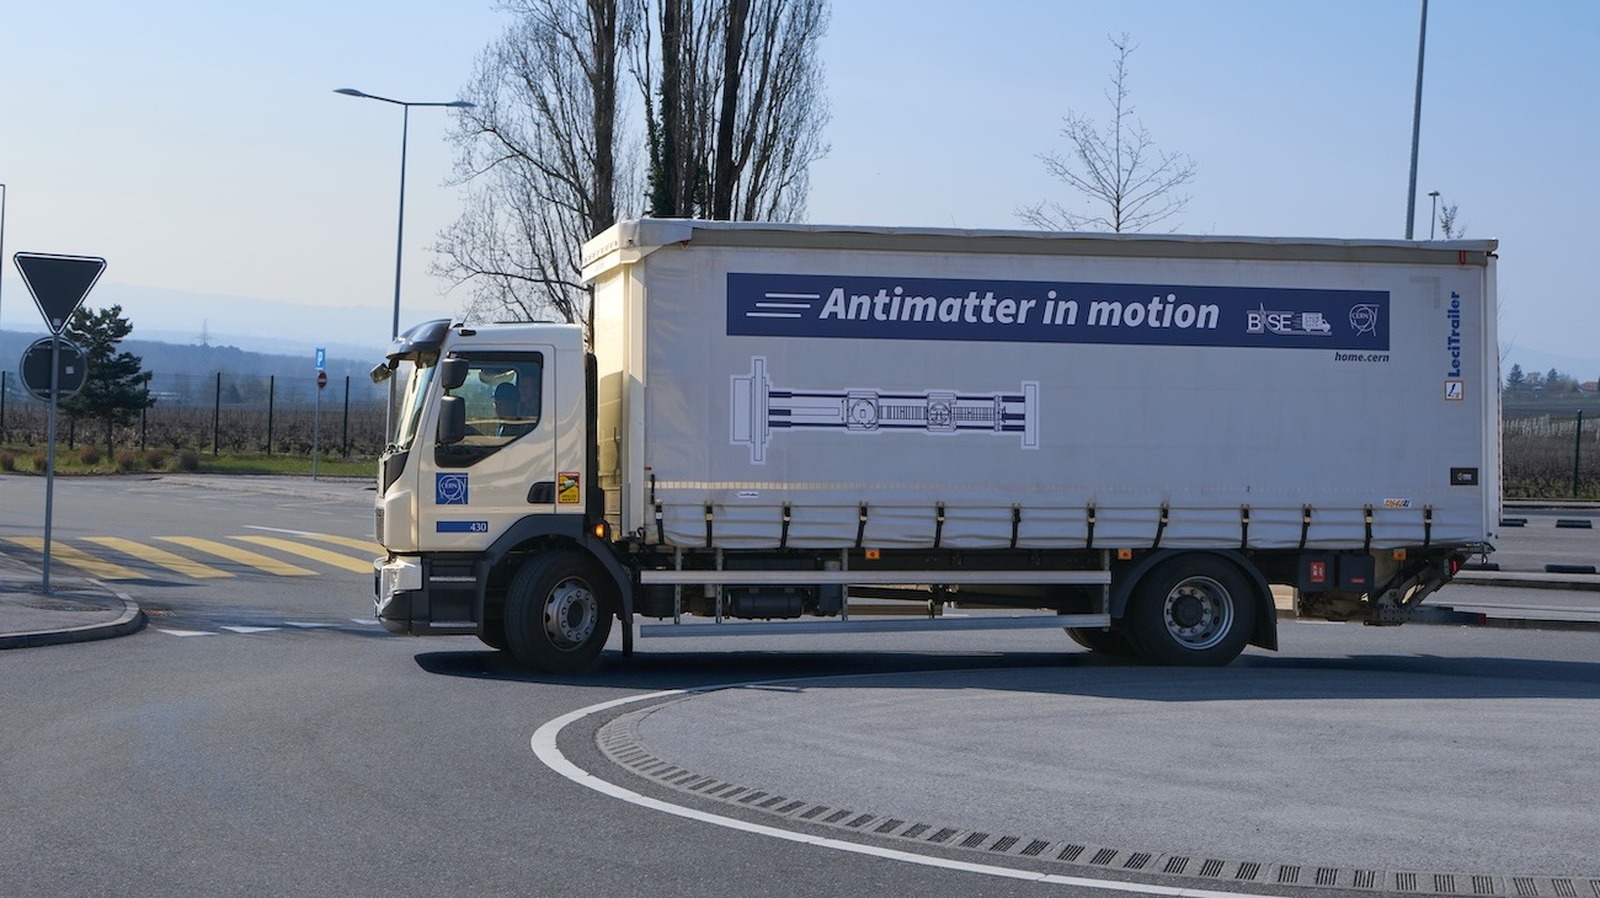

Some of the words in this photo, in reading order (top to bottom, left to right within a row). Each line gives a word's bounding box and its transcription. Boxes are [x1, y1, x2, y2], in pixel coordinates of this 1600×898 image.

[819, 286, 1036, 324] Antimatter
[1042, 290, 1078, 325] in
[1086, 293, 1220, 328] motion
[1352, 312, 1369, 320] CERN
[1447, 292, 1460, 377] LeciTrailer
[317, 350, 324, 367] P
[1335, 351, 1390, 362] home.cern
[470, 522, 487, 532] 430
